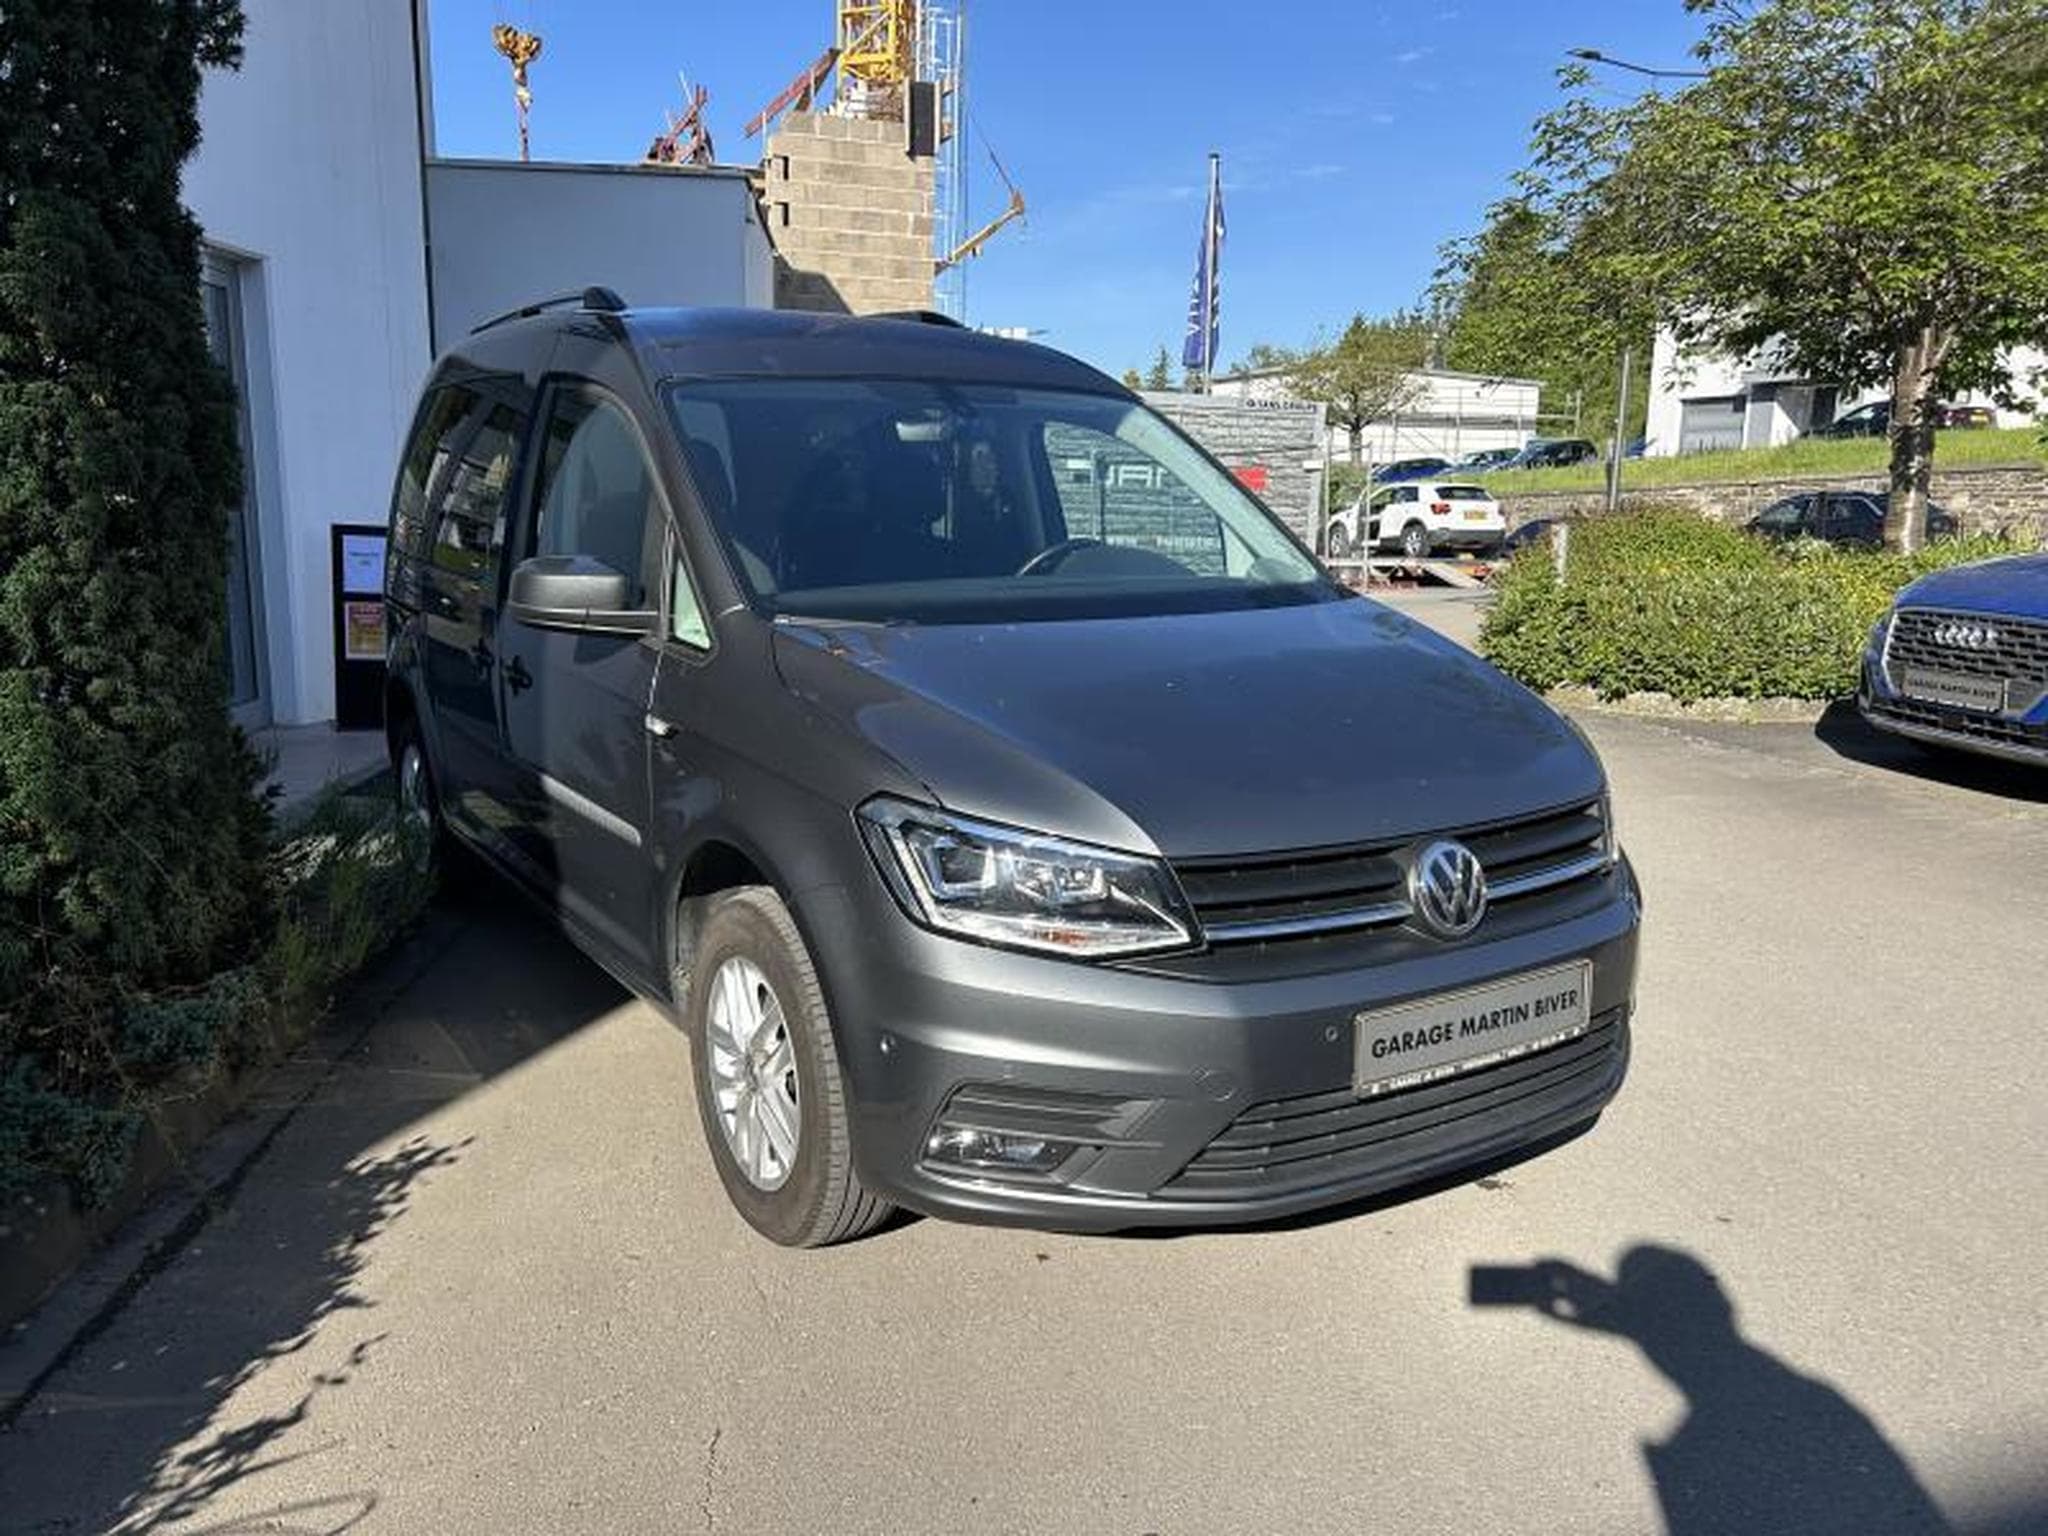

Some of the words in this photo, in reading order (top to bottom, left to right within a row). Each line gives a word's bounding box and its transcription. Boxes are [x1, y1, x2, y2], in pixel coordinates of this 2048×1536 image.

[1371, 1022, 1454, 1059] GARAGE
[1459, 1002, 1529, 1038] MARTIN
[1534, 989, 1578, 1018] BIVER
